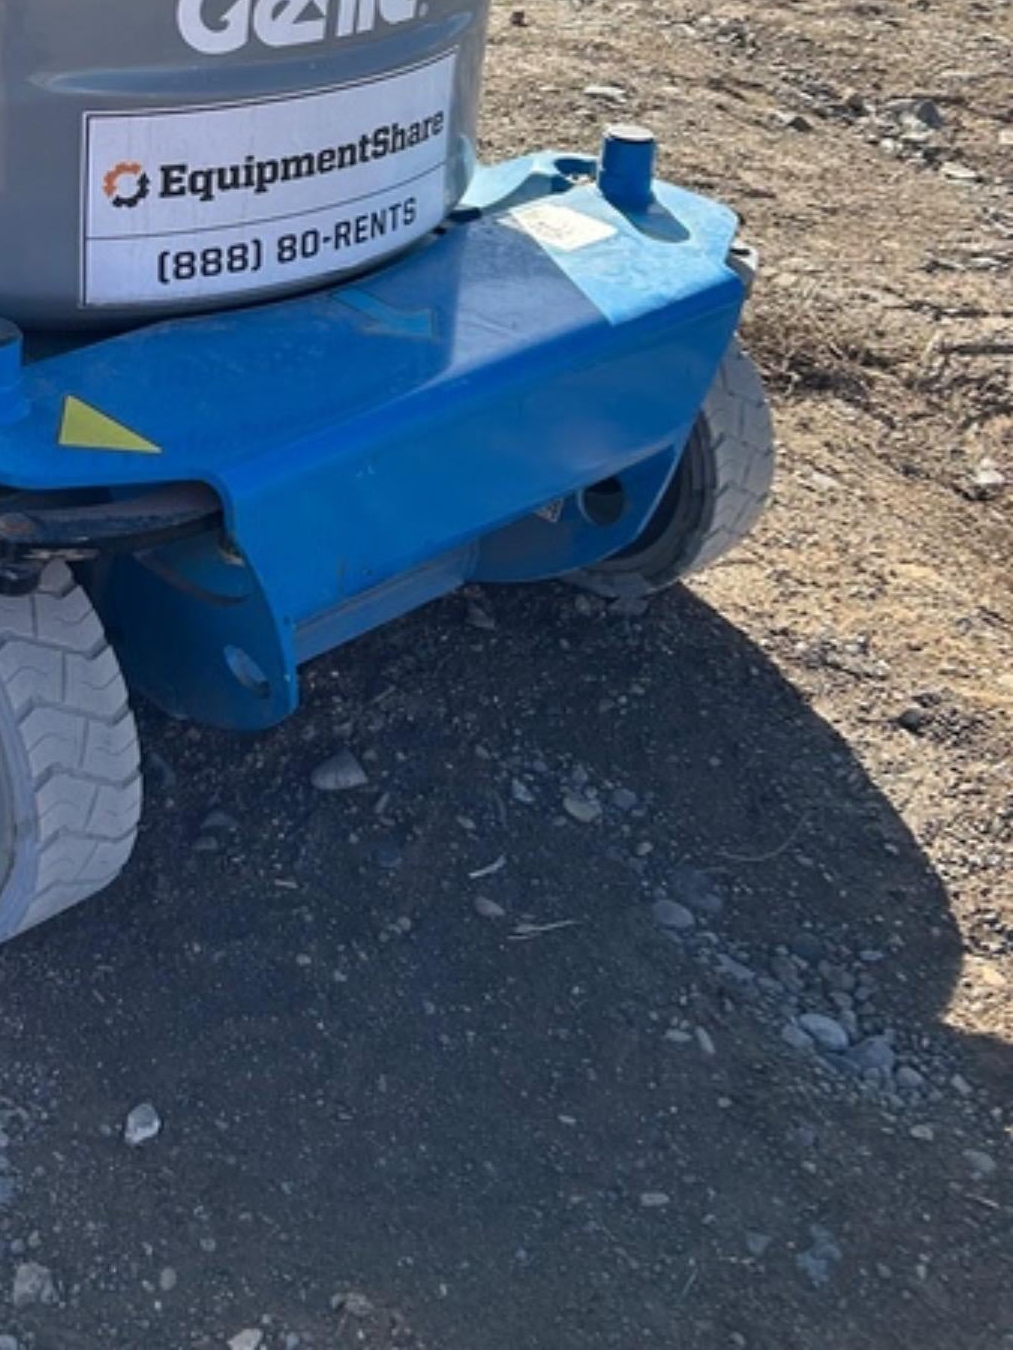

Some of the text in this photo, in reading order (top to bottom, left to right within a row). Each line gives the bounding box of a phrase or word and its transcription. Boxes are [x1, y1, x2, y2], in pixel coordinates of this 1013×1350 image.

[158, 110, 445, 202] EquipmentShare
[156, 196, 418, 285] (888) 80-RENTS
